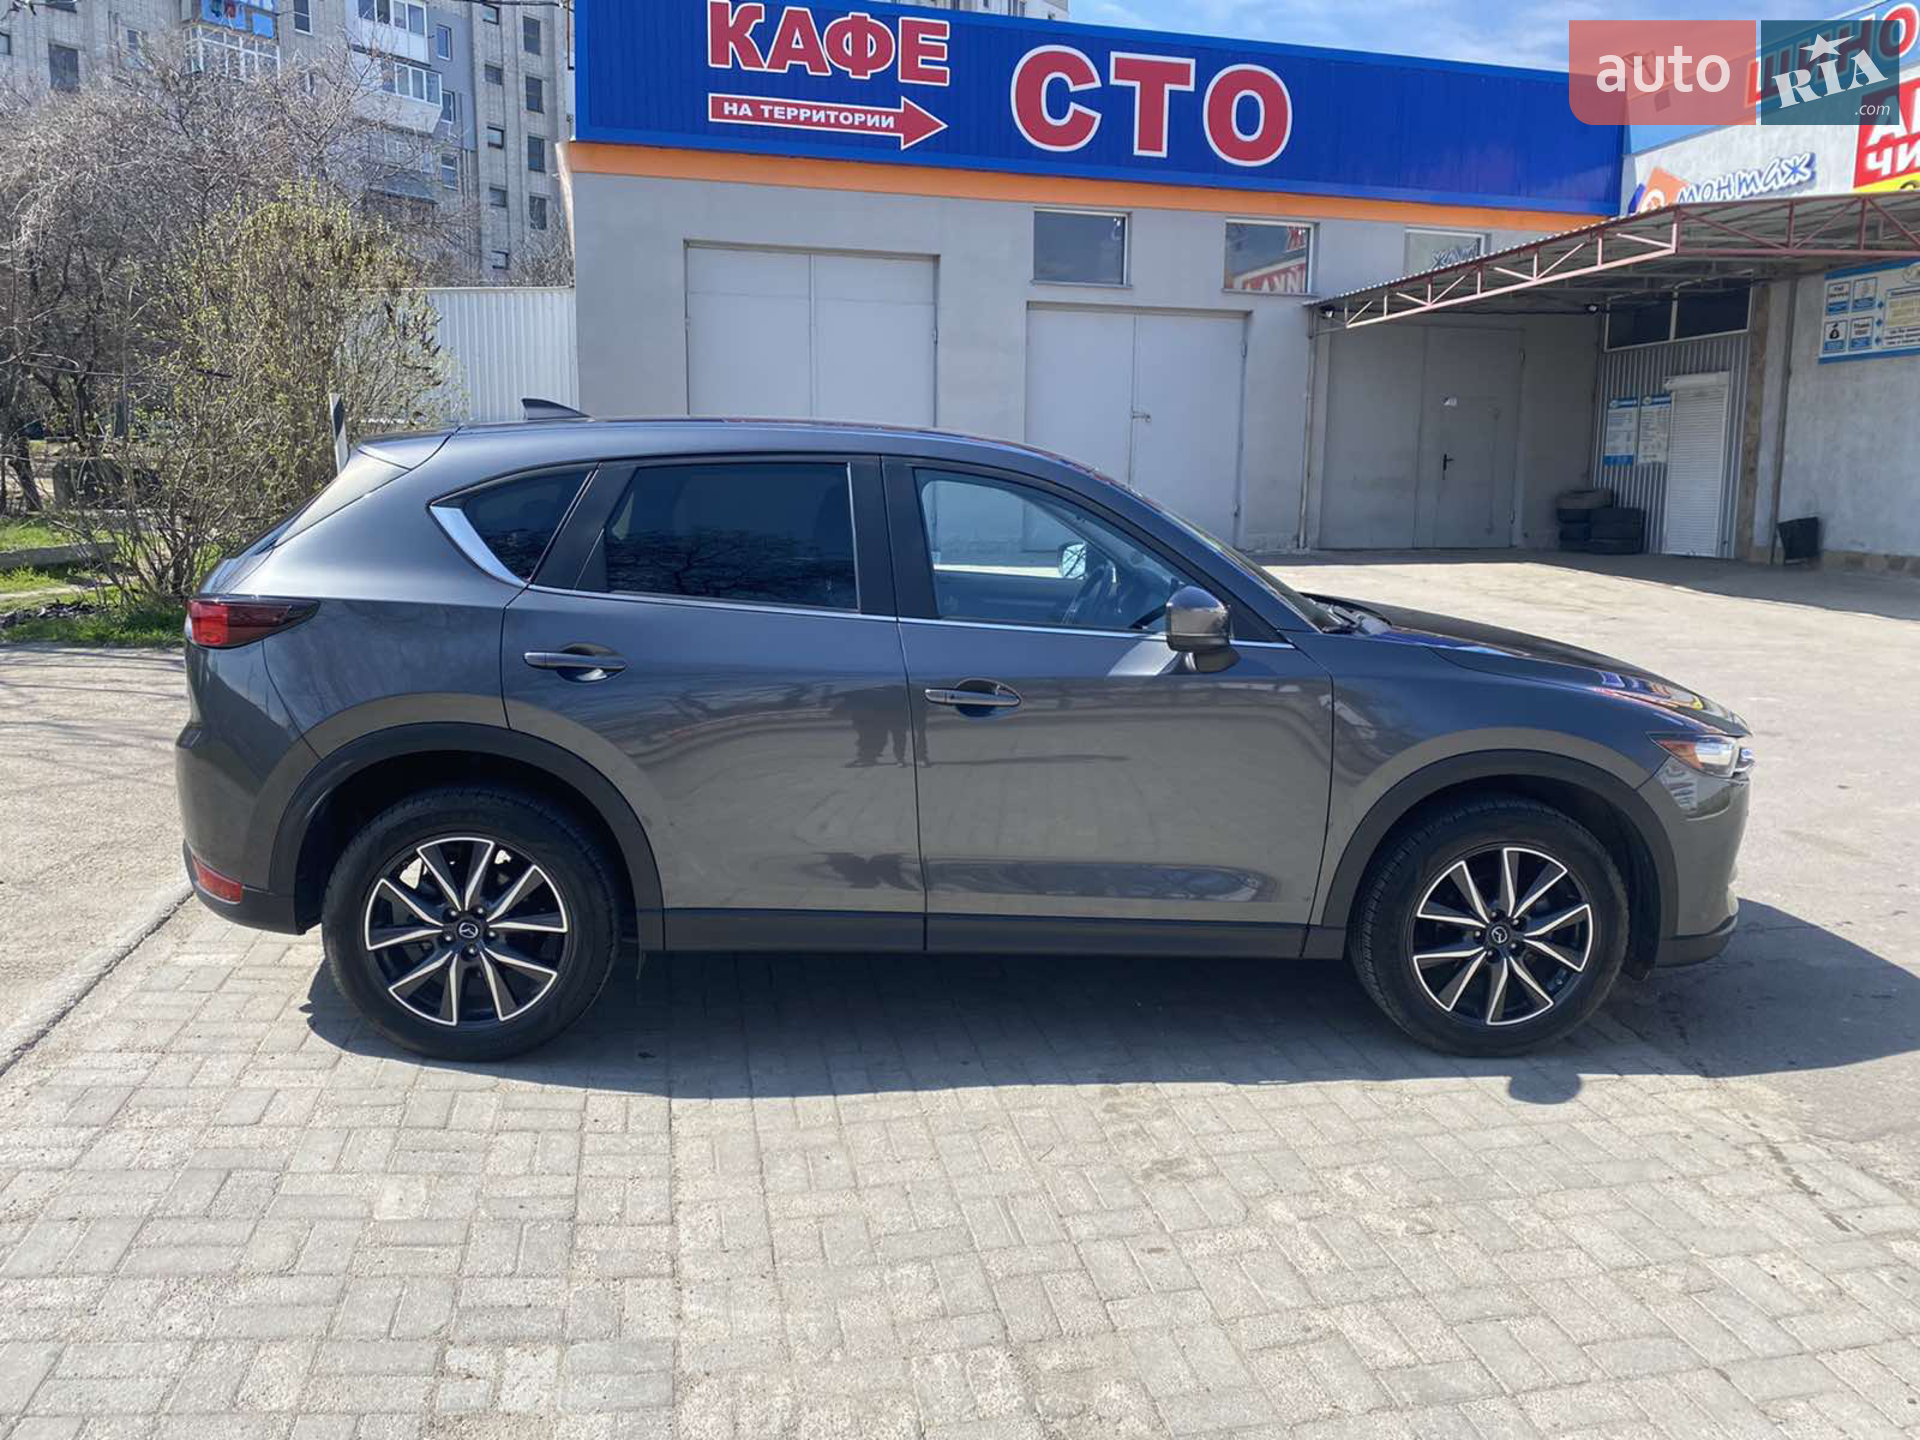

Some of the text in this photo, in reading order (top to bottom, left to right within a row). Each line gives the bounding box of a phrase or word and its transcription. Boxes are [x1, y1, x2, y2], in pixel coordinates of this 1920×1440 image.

[707, 0, 951, 86] КАФЕ
[723, 102, 895, 129] НА ТЕРРИТОРИИ
[1010, 44, 1293, 167] СТО
